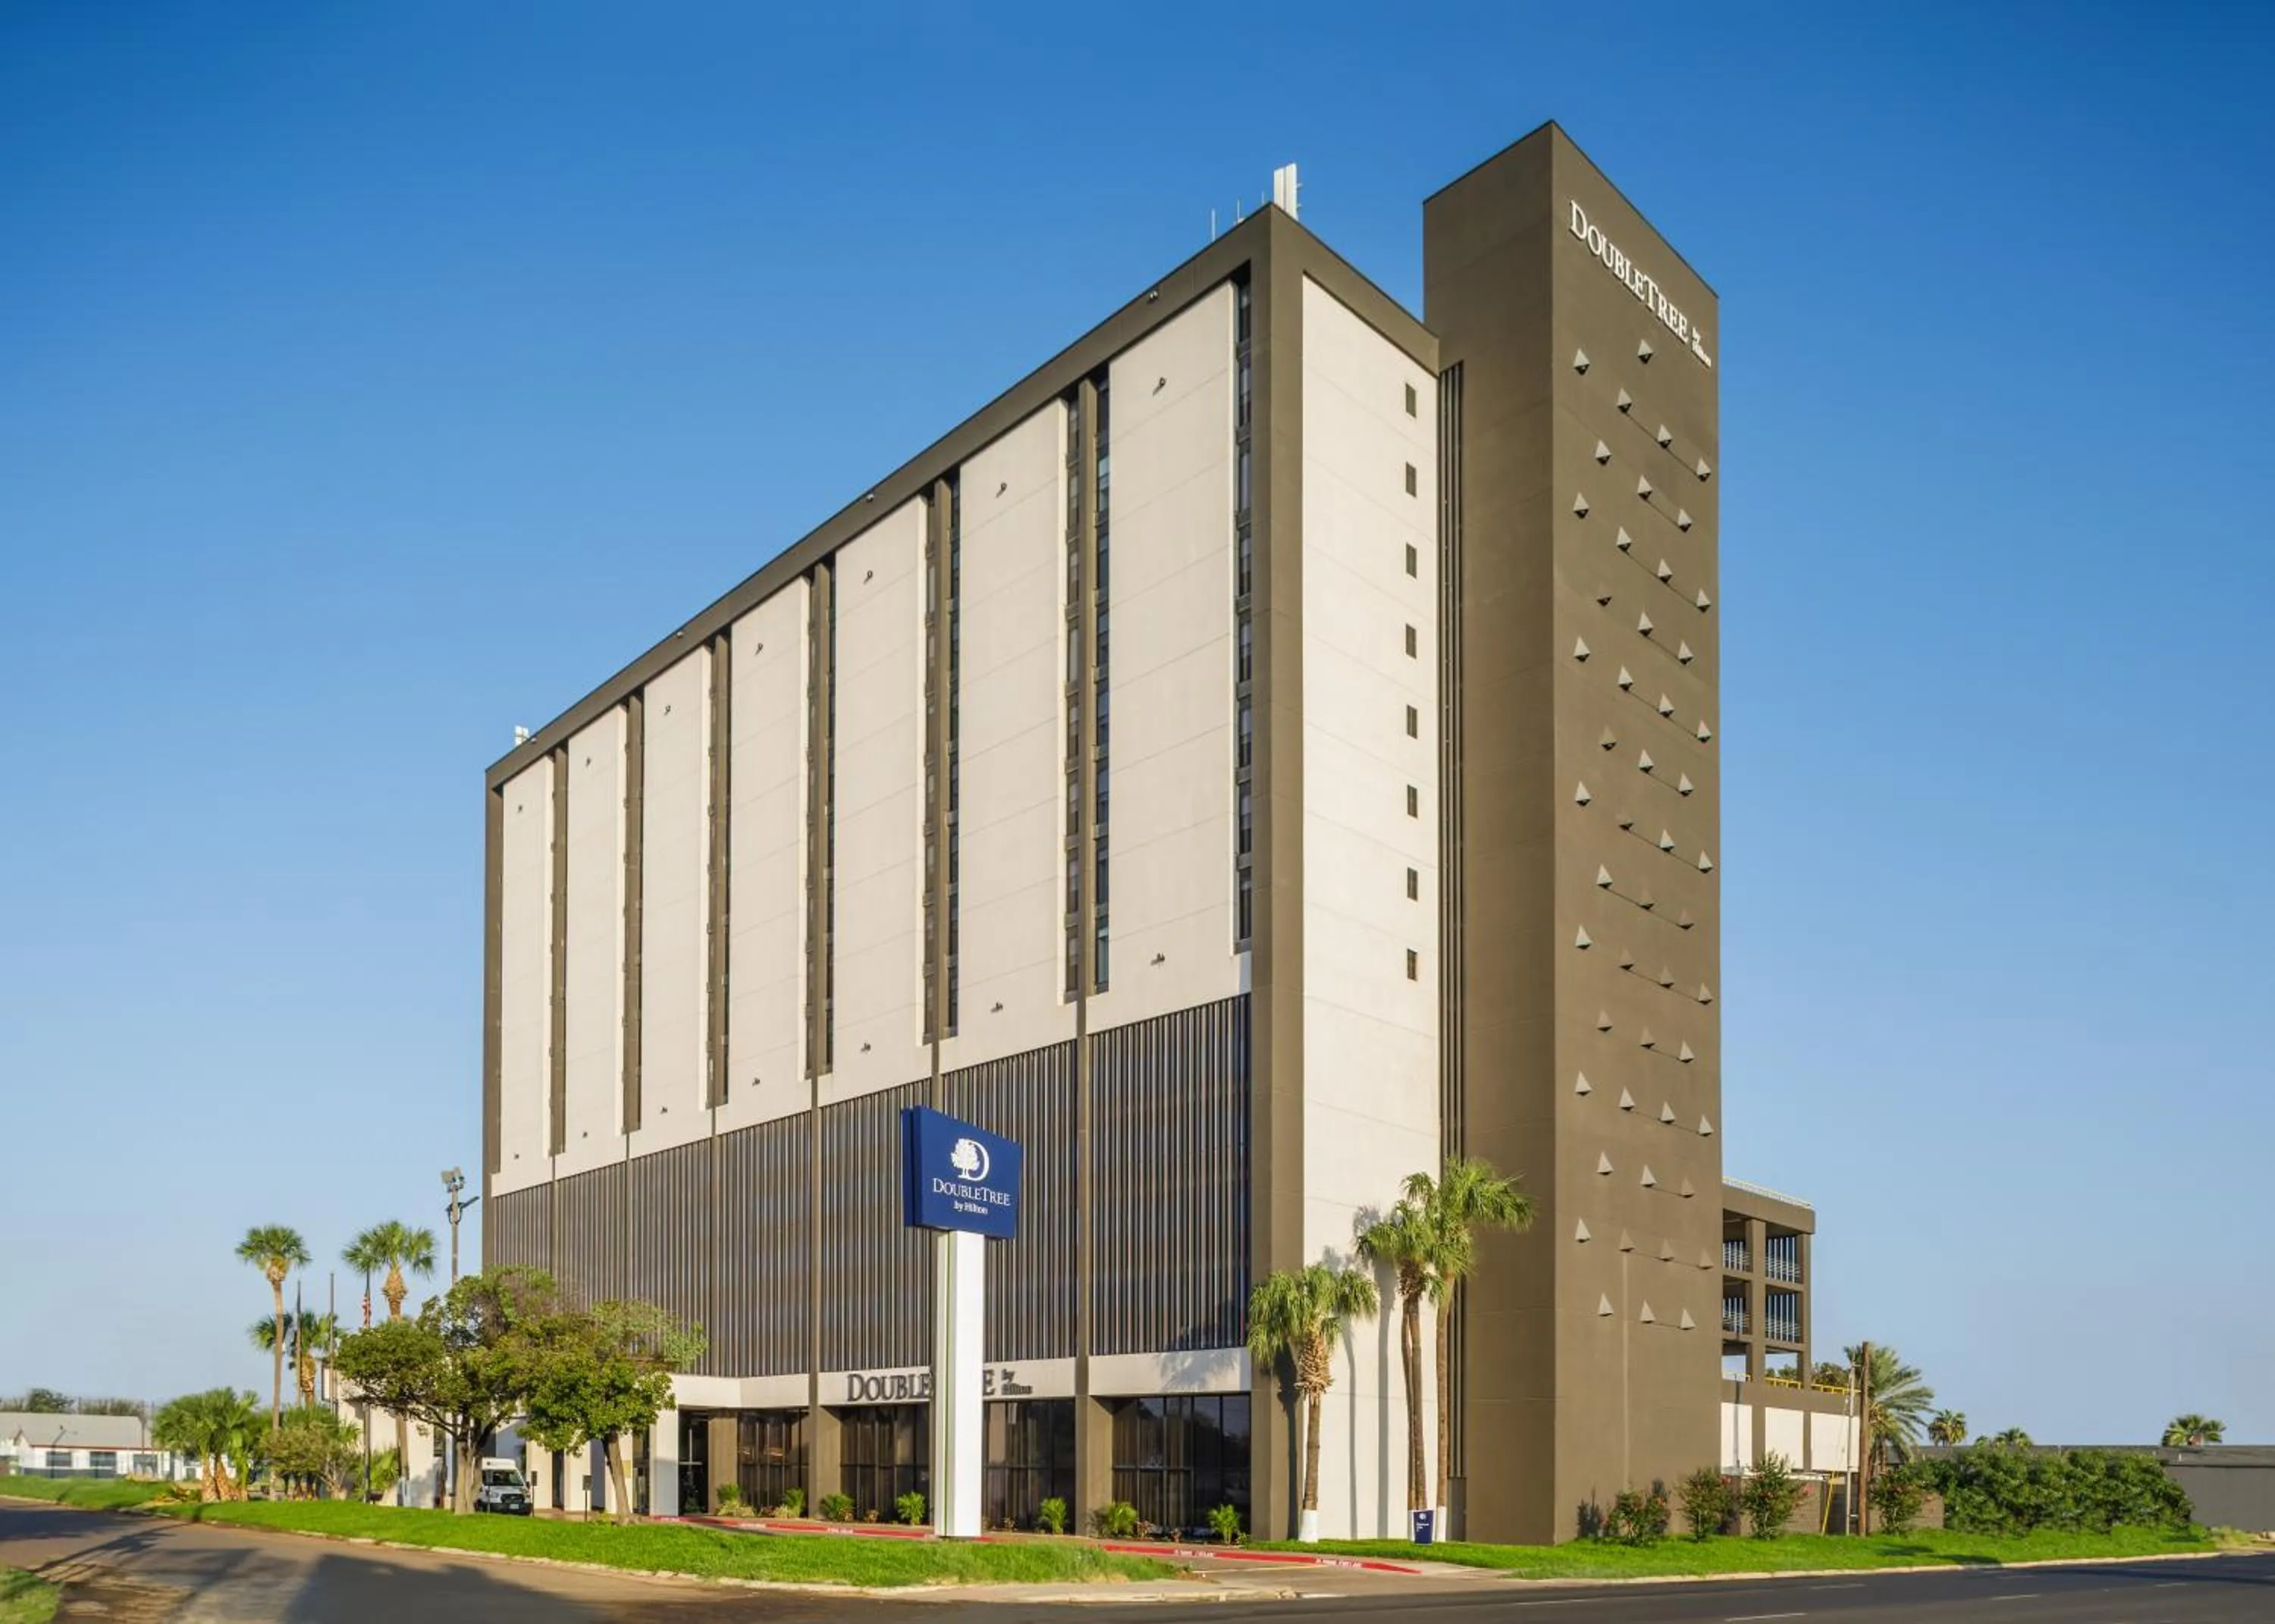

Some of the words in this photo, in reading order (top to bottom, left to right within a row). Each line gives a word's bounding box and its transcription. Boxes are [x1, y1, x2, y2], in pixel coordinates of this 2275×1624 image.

[1570, 199, 1689, 343] DOUBLETREE
[933, 1177, 1012, 1206] DOUBLETREE
[953, 1200, 964, 1212] by
[847, 1369, 996, 1402] DOUBLEE
